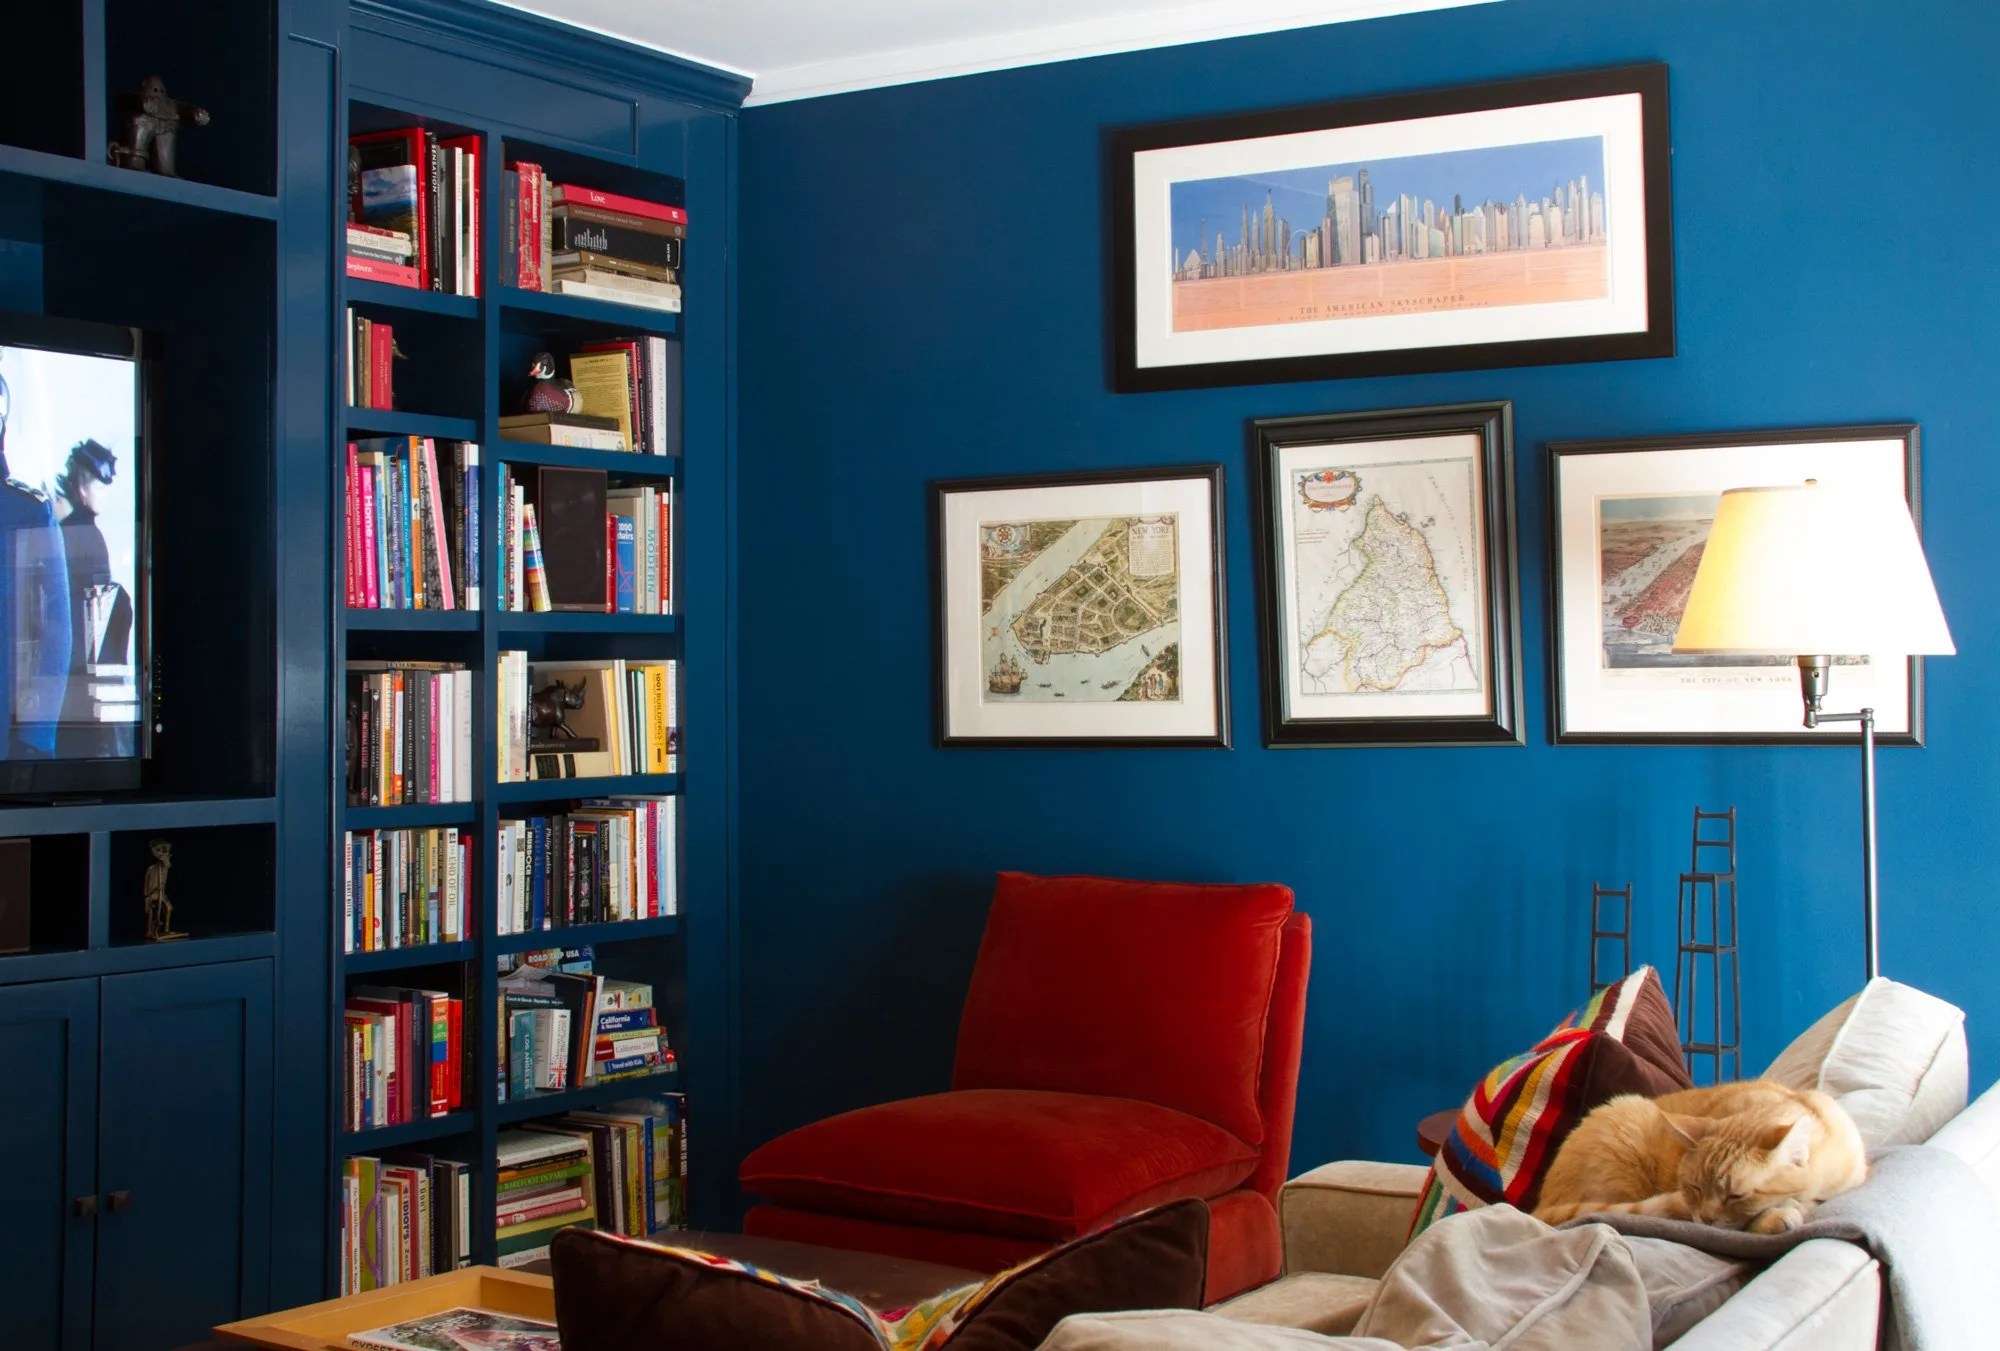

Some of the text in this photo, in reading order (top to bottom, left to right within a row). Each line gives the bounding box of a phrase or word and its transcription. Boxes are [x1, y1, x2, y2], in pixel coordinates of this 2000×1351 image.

[590, 191, 606, 204] Love
[1300, 306, 1318, 315] THE
[1326, 301, 1384, 313] AMERICAN
[1390, 294, 1465, 307] SKYSCRAPER
[364, 495, 373, 537] Home
[392, 503, 400, 551] Landscaping
[617, 523, 633, 532] 1000
[1131, 525, 1169, 535] NEW YORK
[617, 531, 634, 542] chairs
[647, 529, 656, 593] MODERN
[448, 856, 456, 878] END
[448, 878, 456, 892] OF
[448, 893, 456, 908] OIL
[528, 949, 580, 964] ROAD TRIP USA
[600, 1014, 631, 1025] California
[616, 1043, 641, 1053] California
[625, 1060, 634, 1068] with
[634, 1058, 644, 1066] Kids
[681, 1152, 687, 1160] TO
[504, 1171, 568, 1190] BAREFOOT IN PARIS
